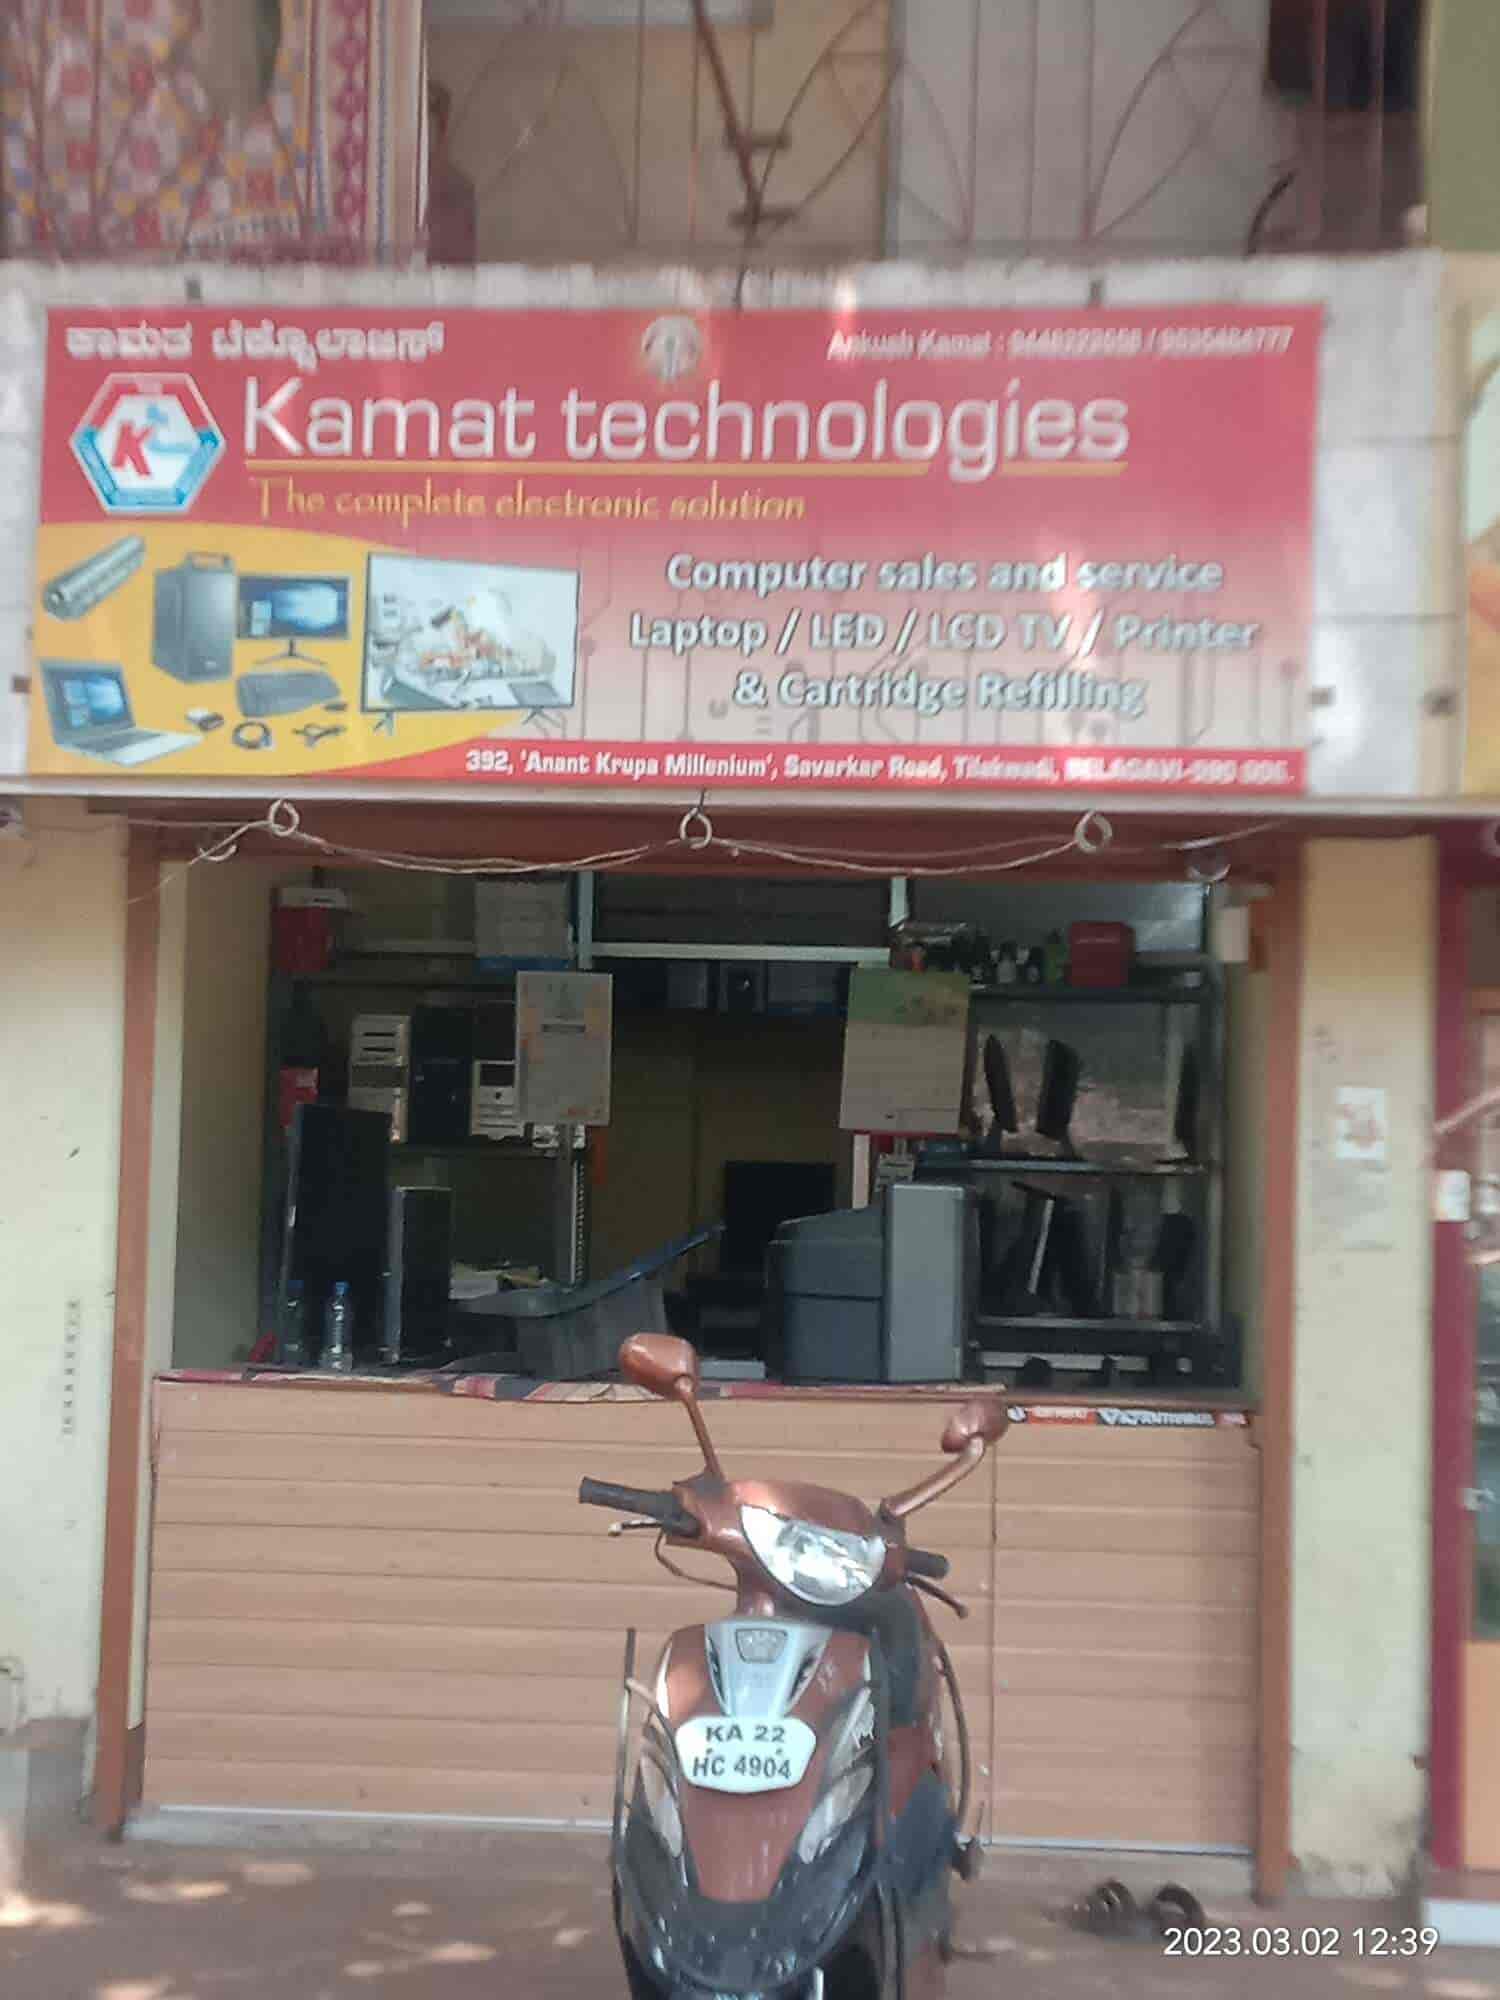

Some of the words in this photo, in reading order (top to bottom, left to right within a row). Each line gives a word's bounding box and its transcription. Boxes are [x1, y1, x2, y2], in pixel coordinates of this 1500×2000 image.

[244, 376, 537, 459] Kamat
[561, 378, 1131, 483] technologies
[250, 476, 326, 518] The
[334, 478, 487, 529] complete
[495, 478, 659, 519] electronic
[669, 480, 805, 521] solution
[666, 552, 868, 599] Computer
[878, 551, 977, 592] sales
[988, 551, 1069, 592] and
[1076, 553, 1224, 592] service
[629, 610, 768, 655] Laptop
[775, 606, 802, 655] /
[810, 611, 886, 650] LED
[893, 606, 919, 656] /
[929, 611, 1006, 650] LCD
[1014, 612, 1073, 651] TV
[1113, 613, 1262, 652] Printer
[732, 669, 769, 706] &
[777, 668, 967, 717] Cartridge
[978, 669, 1149, 720] Refilling
[465, 750, 514, 777] 392,
[595, 753, 659, 781] Krupa
[783, 755, 884, 780] Savarkar
[888, 755, 947, 783] Road,
[705, 1724, 744, 1743] KA
[753, 1725, 786, 1743] 22
[693, 1756, 725, 1778] HC
[734, 1756, 792, 1779] 4904
